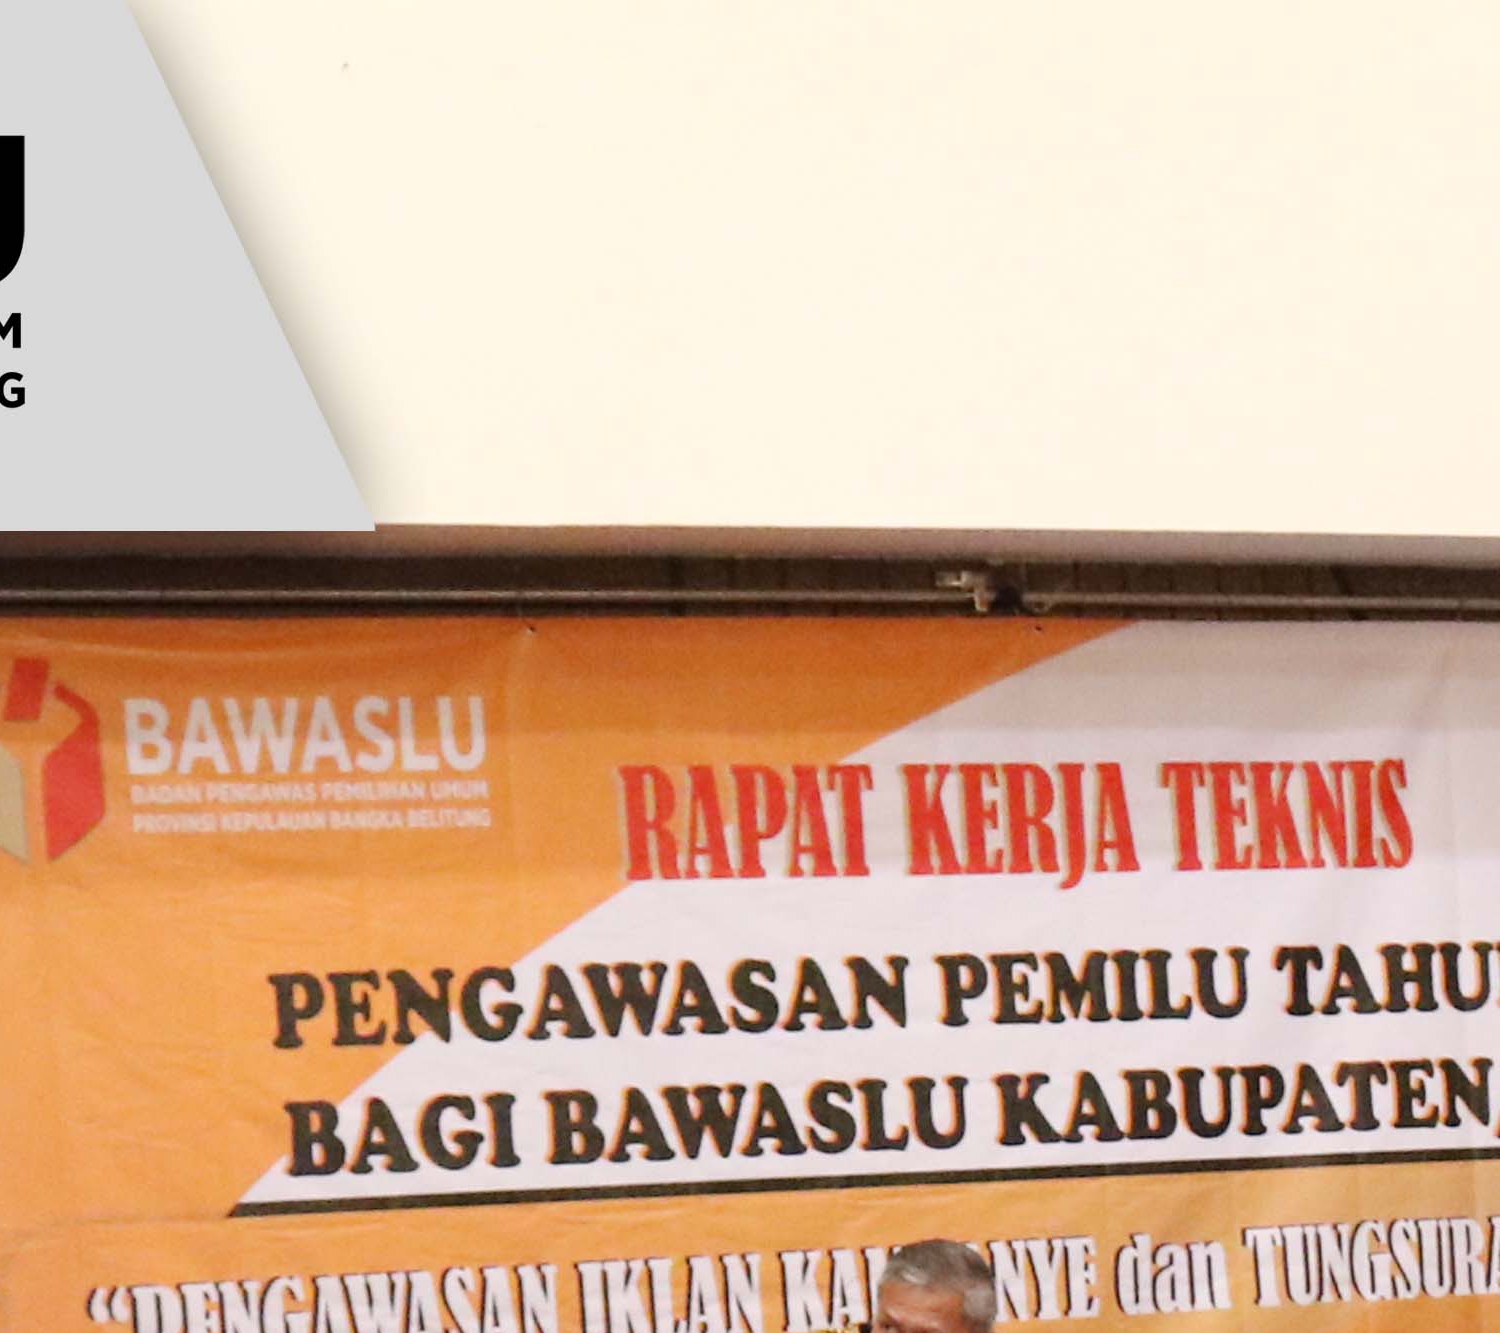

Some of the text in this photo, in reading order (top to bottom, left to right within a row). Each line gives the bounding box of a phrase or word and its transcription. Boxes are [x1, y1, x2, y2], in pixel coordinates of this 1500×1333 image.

[124, 696, 488, 775] BAWASLU
[131, 783, 201, 805] BADAN
[207, 782, 317, 803] PENGAWAS
[321, 780, 425, 801] PEMILIHAN
[133, 811, 216, 833] PROVINSI
[331, 809, 403, 830] BANGKA
[407, 807, 492, 828] BELITUNG
[615, 757, 1415, 891] RAPAT KERJA TEKNIS
[268, 954, 910, 1049] PENGAWASAN
[934, 946, 1250, 1027] PEMILU
[284, 1092, 522, 1177] BAGI
[542, 1075, 969, 1166] BAWASLU
[1115, 1232, 1232, 1315] dan
